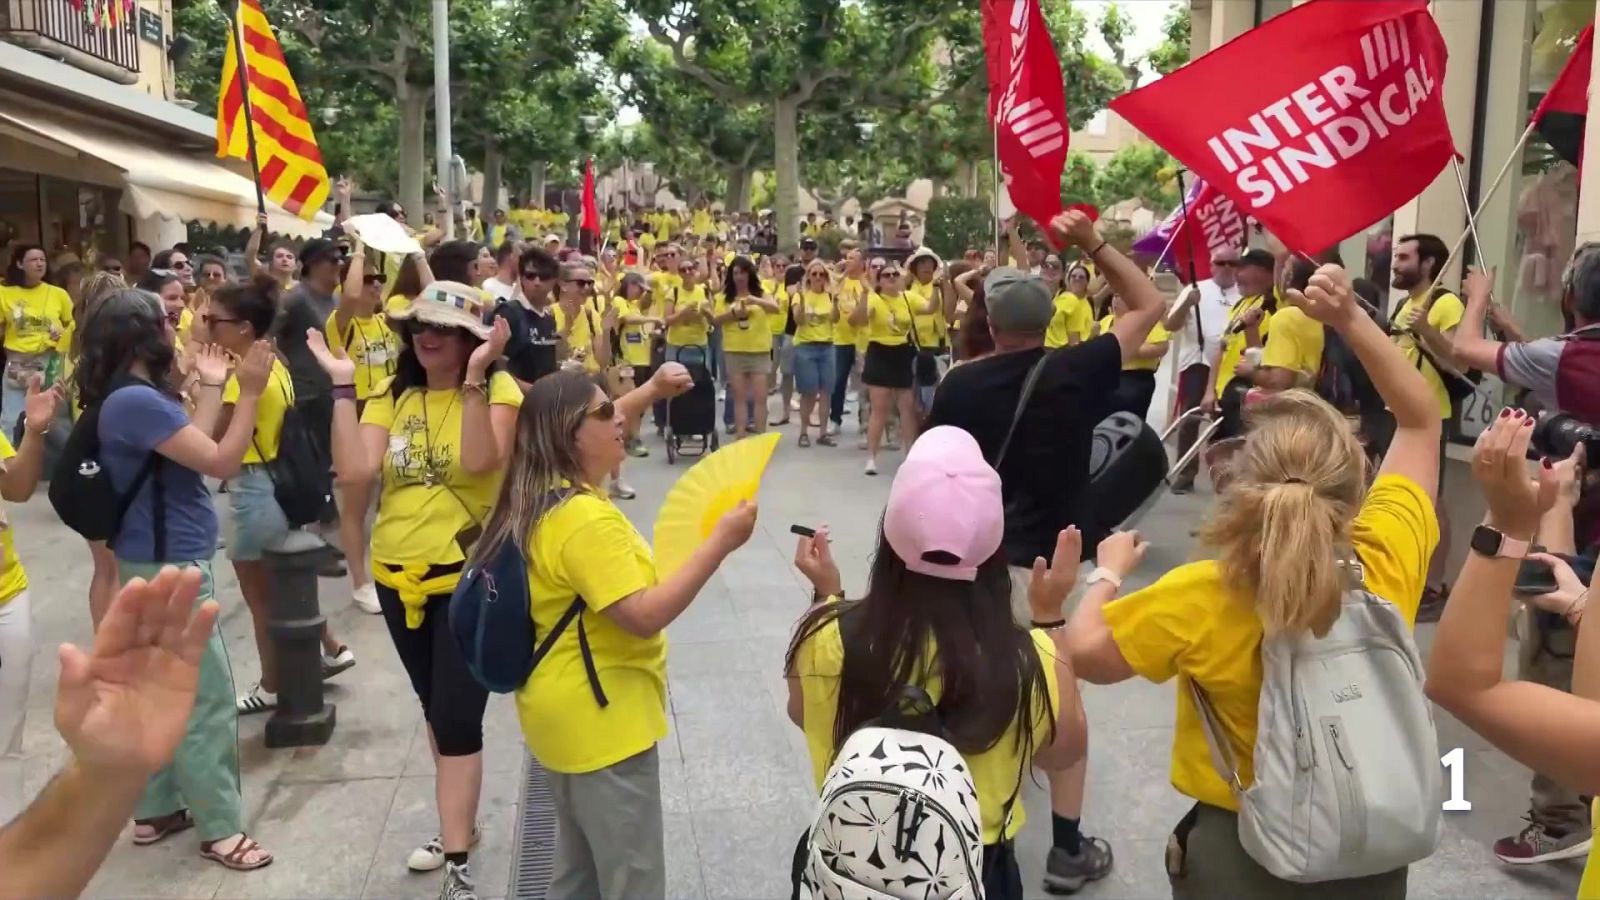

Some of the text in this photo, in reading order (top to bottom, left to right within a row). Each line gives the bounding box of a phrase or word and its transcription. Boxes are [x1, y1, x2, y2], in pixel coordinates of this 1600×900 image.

[1207, 65, 1371, 173] INTER
[1236, 53, 1433, 208] SINDICAL
[1463, 391, 1493, 424] 26
